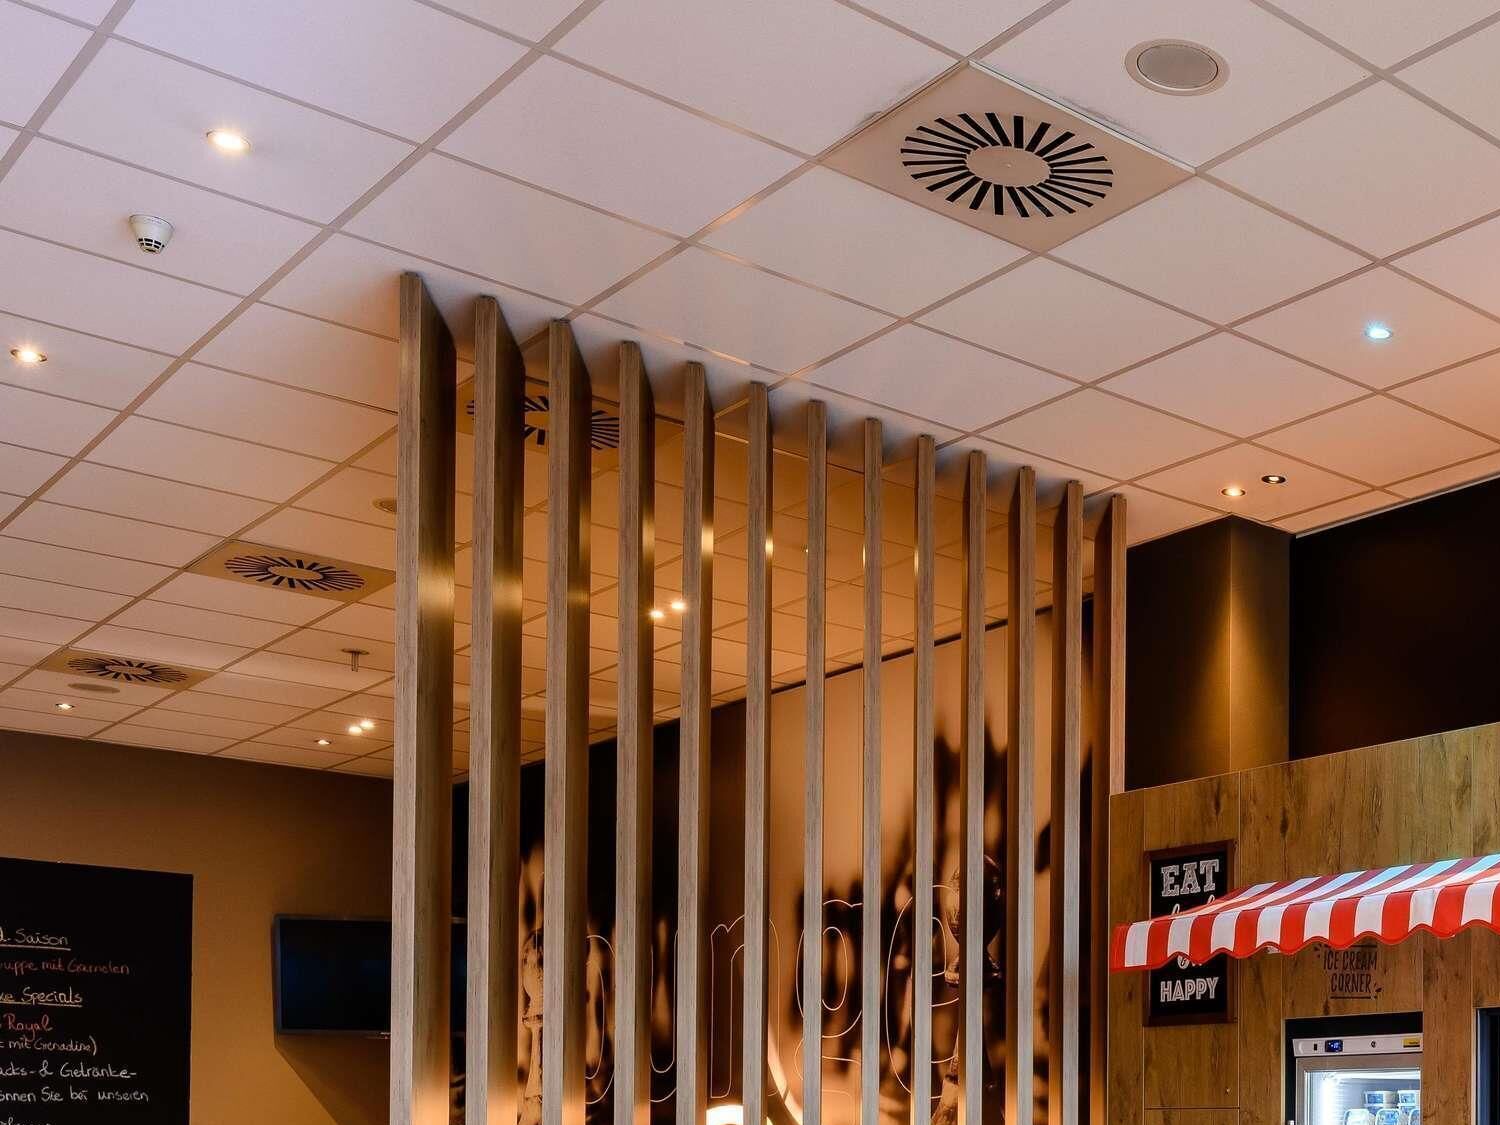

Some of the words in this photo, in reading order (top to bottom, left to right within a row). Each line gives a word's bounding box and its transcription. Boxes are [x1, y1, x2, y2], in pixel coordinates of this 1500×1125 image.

[1160, 859, 1220, 897] EAT
[16, 928, 69, 946] Saison
[41, 957, 65, 972] mit
[1323, 950, 1339, 970] ICE
[1343, 950, 1378, 970] CREAM
[1160, 976, 1220, 1003] HAPPY
[1330, 973, 1372, 994] CORNER
[3, 1012, 53, 1041] Royal
[40, 1060, 54, 1077] &
[41, 1085, 64, 1102] Sie
[70, 1083, 89, 1100] bei
